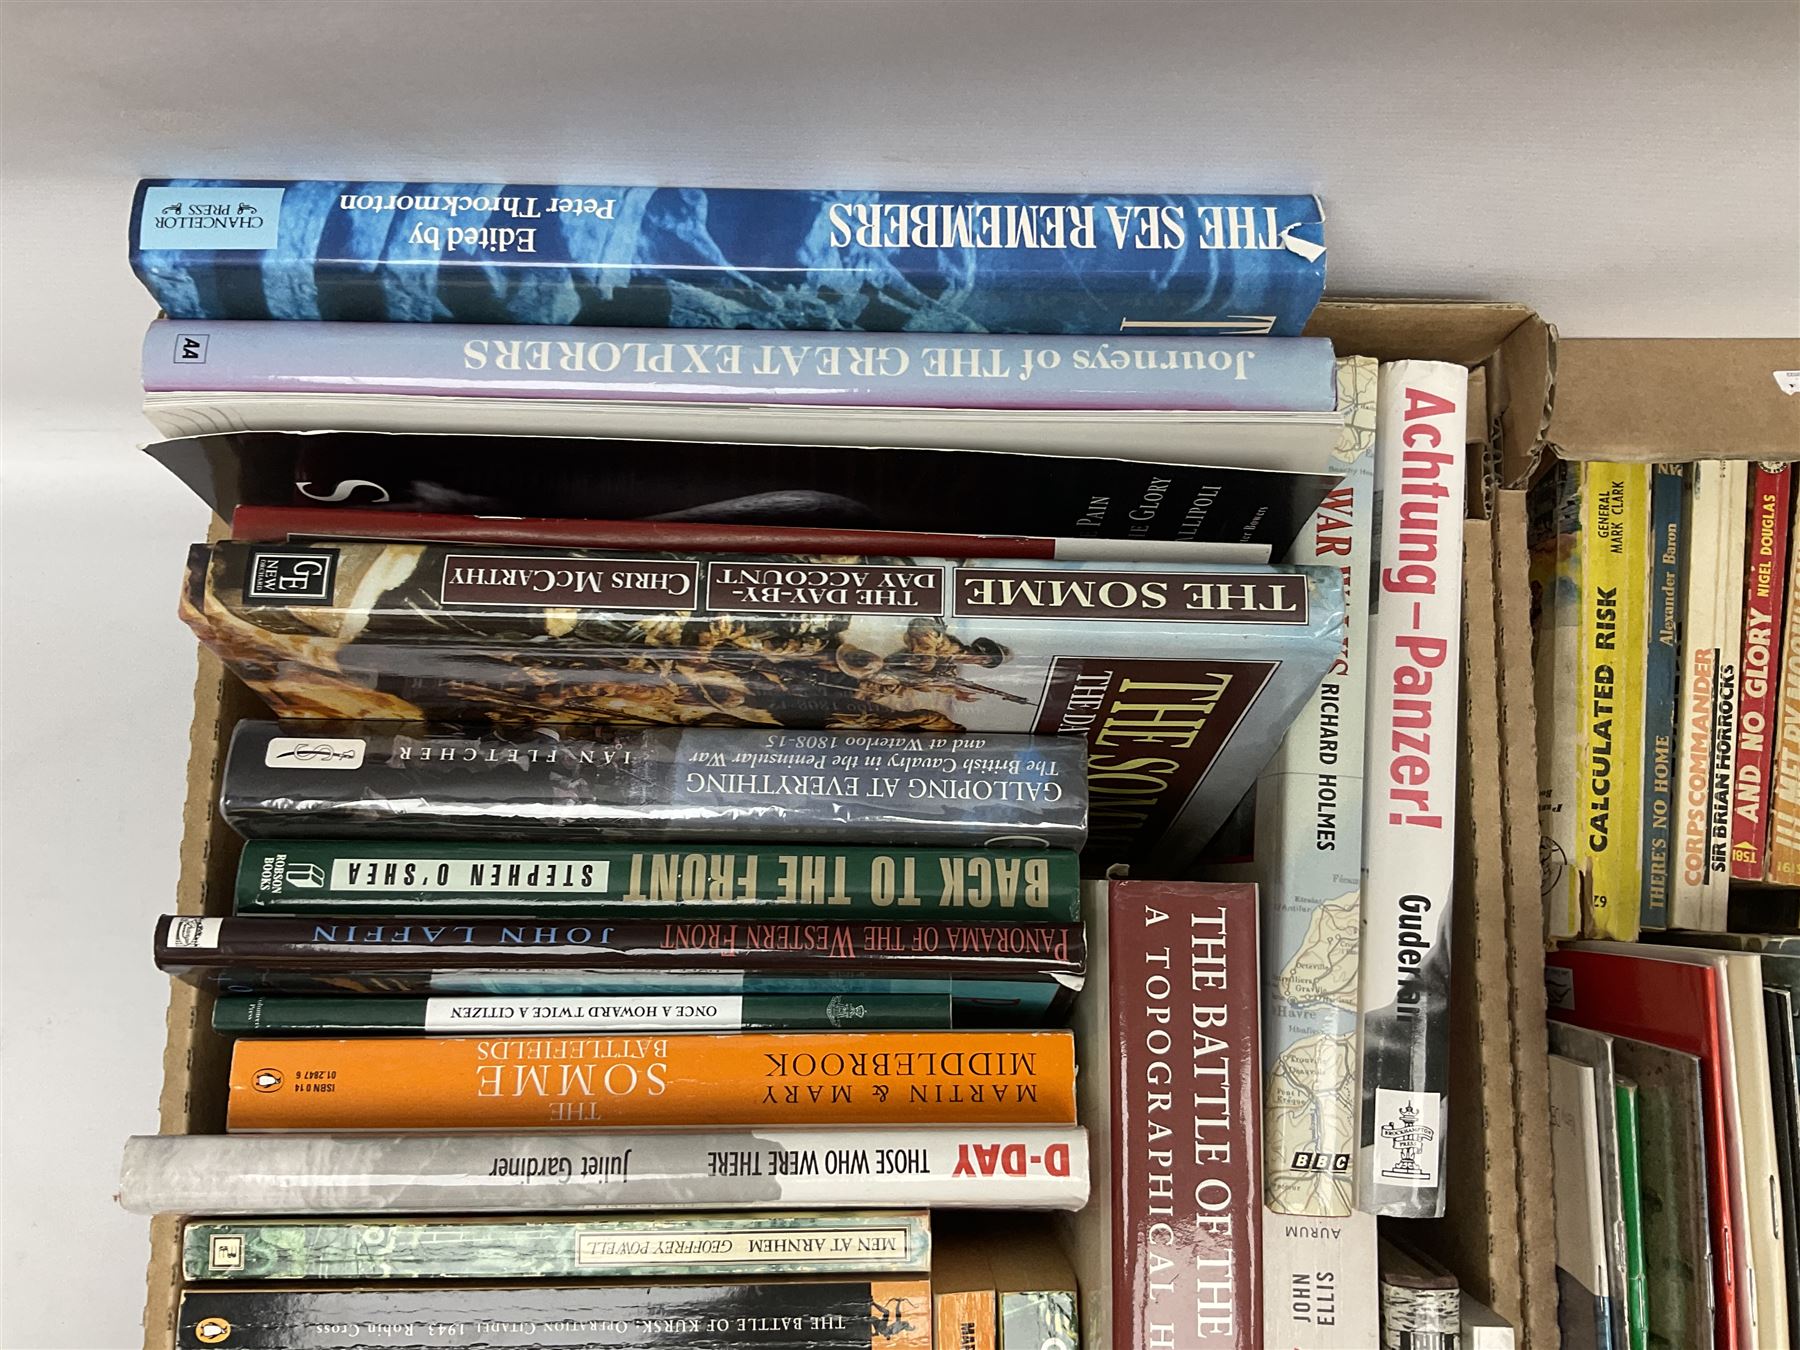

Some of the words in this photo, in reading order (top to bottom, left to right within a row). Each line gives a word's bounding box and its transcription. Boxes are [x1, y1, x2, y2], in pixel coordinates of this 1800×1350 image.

[189, 204, 231, 216] PRESS
[339, 195, 541, 218] Throckmorton
[545, 199, 616, 220] Peter
[155, 215, 264, 230] CHANCELLOR
[829, 203, 1097, 250] REMEMBERS
[1104, 205, 1185, 250] SEA
[1199, 207, 1287, 250] THE
[409, 225, 441, 251] by
[447, 226, 537, 253] Edited
[182, 337, 200, 360] AA
[463, 340, 743, 374] EXPLORERS
[752, 345, 909, 377] GREAT
[922, 348, 1011, 378] THE
[1018, 349, 1062, 380] of
[1073, 347, 1256, 381] Journeys
[1128, 477, 1172, 521] GLORY
[1612, 481, 1624, 515] CLARK
[1076, 496, 1111, 527] PAIN
[1315, 487, 1354, 556] WAR
[1598, 491, 1610, 538] GENERAL
[1611, 522, 1623, 553] MARK
[1760, 494, 1776, 556] DOUGLAS
[1663, 523, 1677, 564] Baron
[256, 558, 265, 591] ORCHARD
[263, 559, 279, 592] NEW
[716, 569, 870, 587] ACCOUNT
[878, 573, 936, 589] DAY
[1757, 561, 1771, 597] NIGEL
[732, 587, 848, 605] DAY-BY-
[856, 590, 918, 606] THE
[964, 577, 1168, 609] SOMME
[1184, 581, 1298, 612] THE
[1595, 587, 1617, 650] RISK
[1659, 571, 1677, 646] Alexander
[1744, 606, 1773, 698] GLORY
[1065, 670, 1113, 710] THE
[1095, 672, 1234, 749] THE
[1716, 664, 1735, 771] HORROCKS
[1319, 683, 1339, 765] RICHARD
[1688, 648, 1714, 805] COMMANDER
[1740, 711, 1766, 751] NO
[399, 746, 562, 763] FLETCHER
[766, 735, 837, 749] 1808-15
[844, 736, 923, 751] Waterloo
[928, 737, 948, 750] at
[952, 737, 986, 751] and
[579, 750, 631, 765] IAN
[688, 751, 726, 766] War
[732, 751, 826, 768] Peninsular
[832, 753, 860, 769] the
[863, 755, 882, 769] in
[885, 754, 957, 773] Cavalry
[965, 756, 1021, 774] British
[1026, 760, 1059, 775] The
[1589, 664, 1614, 852] CALCULATED
[1654, 735, 1669, 792] HOME
[686, 773, 860, 797] EVERYTHING
[867, 776, 900, 798] AT
[907, 779, 1063, 802] GALLOPING
[1735, 764, 1762, 823] AND
[1317, 774, 1337, 851] HOLMES
[1653, 799, 1668, 829] NO
[1684, 808, 1706, 887] CORPS
[260, 856, 274, 891] BOOKS
[271, 854, 286, 893] ROBSON
[348, 862, 449, 886] O'SHEA
[470, 864, 592, 887] STEPHEN
[623, 853, 758, 903] FRONT
[778, 856, 851, 905] THE
[870, 857, 921, 906] TO
[939, 858, 1049, 908] BACK
[1649, 838, 1666, 908] THERE'S
[1145, 904, 1170, 927] A
[312, 925, 473, 943] LAFFIN
[500, 927, 615, 945] JOHN
[660, 924, 737, 957] FRONT
[746, 925, 855, 959] WESTERN
[864, 926, 907, 951] THE
[912, 927, 939, 951] OF
[946, 927, 1068, 961] PANORAMA
[1191, 906, 1228, 991] THE
[450, 1007, 514, 1018] CITIZEN
[520, 1007, 529, 1018] A
[533, 1006, 584, 1018] TWICE
[588, 1006, 656, 1017] HOWARD
[663, 1006, 672, 1017] A
[676, 1006, 717, 1017] ONCE
[1277, 1006, 1317, 1020] Havre
[477, 1039, 669, 1061] BATTLEFIELDS
[764, 1052, 1036, 1077] MIDDLEBROOK
[313, 1084, 336, 1093] ISBN
[477, 1062, 669, 1097] SOMME
[1192, 1003, 1231, 1165] BATTLE
[762, 1085, 852, 1104] MARY
[871, 1085, 889, 1103] &
[910, 1084, 1037, 1103] MARTIN
[549, 1101, 600, 1121] THE
[1145, 947, 1174, 1300] TOPOGRAPHICAL
[489, 1151, 572, 1184] Gardiner
[580, 1149, 632, 1182] Juliet
[707, 1150, 764, 1176] THERE
[768, 1150, 819, 1175] WERE
[825, 1150, 871, 1174] WHO
[876, 1150, 930, 1174] THOSE
[952, 1143, 1070, 1178] D-DAY
[1293, 1153, 1349, 1171] BBC
[1195, 1178, 1232, 1236] OF
[748, 1236, 827, 1252] ARNHEM
[830, 1233, 852, 1251] AT
[856, 1232, 897, 1251] MEN
[1285, 1226, 1341, 1239] AURUM
[587, 1240, 650, 1256] POWELL
[655, 1238, 733, 1254] GEOFFREY
[1196, 1248, 1235, 1338] THE
[1292, 1273, 1311, 1322] JOHN
[1316, 1271, 1335, 1326] ELLIS
[317, 1322, 362, 1336] Cross
[367, 1321, 413, 1336] Robin
[428, 1323, 465, 1336] 1943
[707, 1317, 730, 1333] OF
[738, 1317, 802, 1331] BATTLE
[811, 1316, 845, 1330] THE
